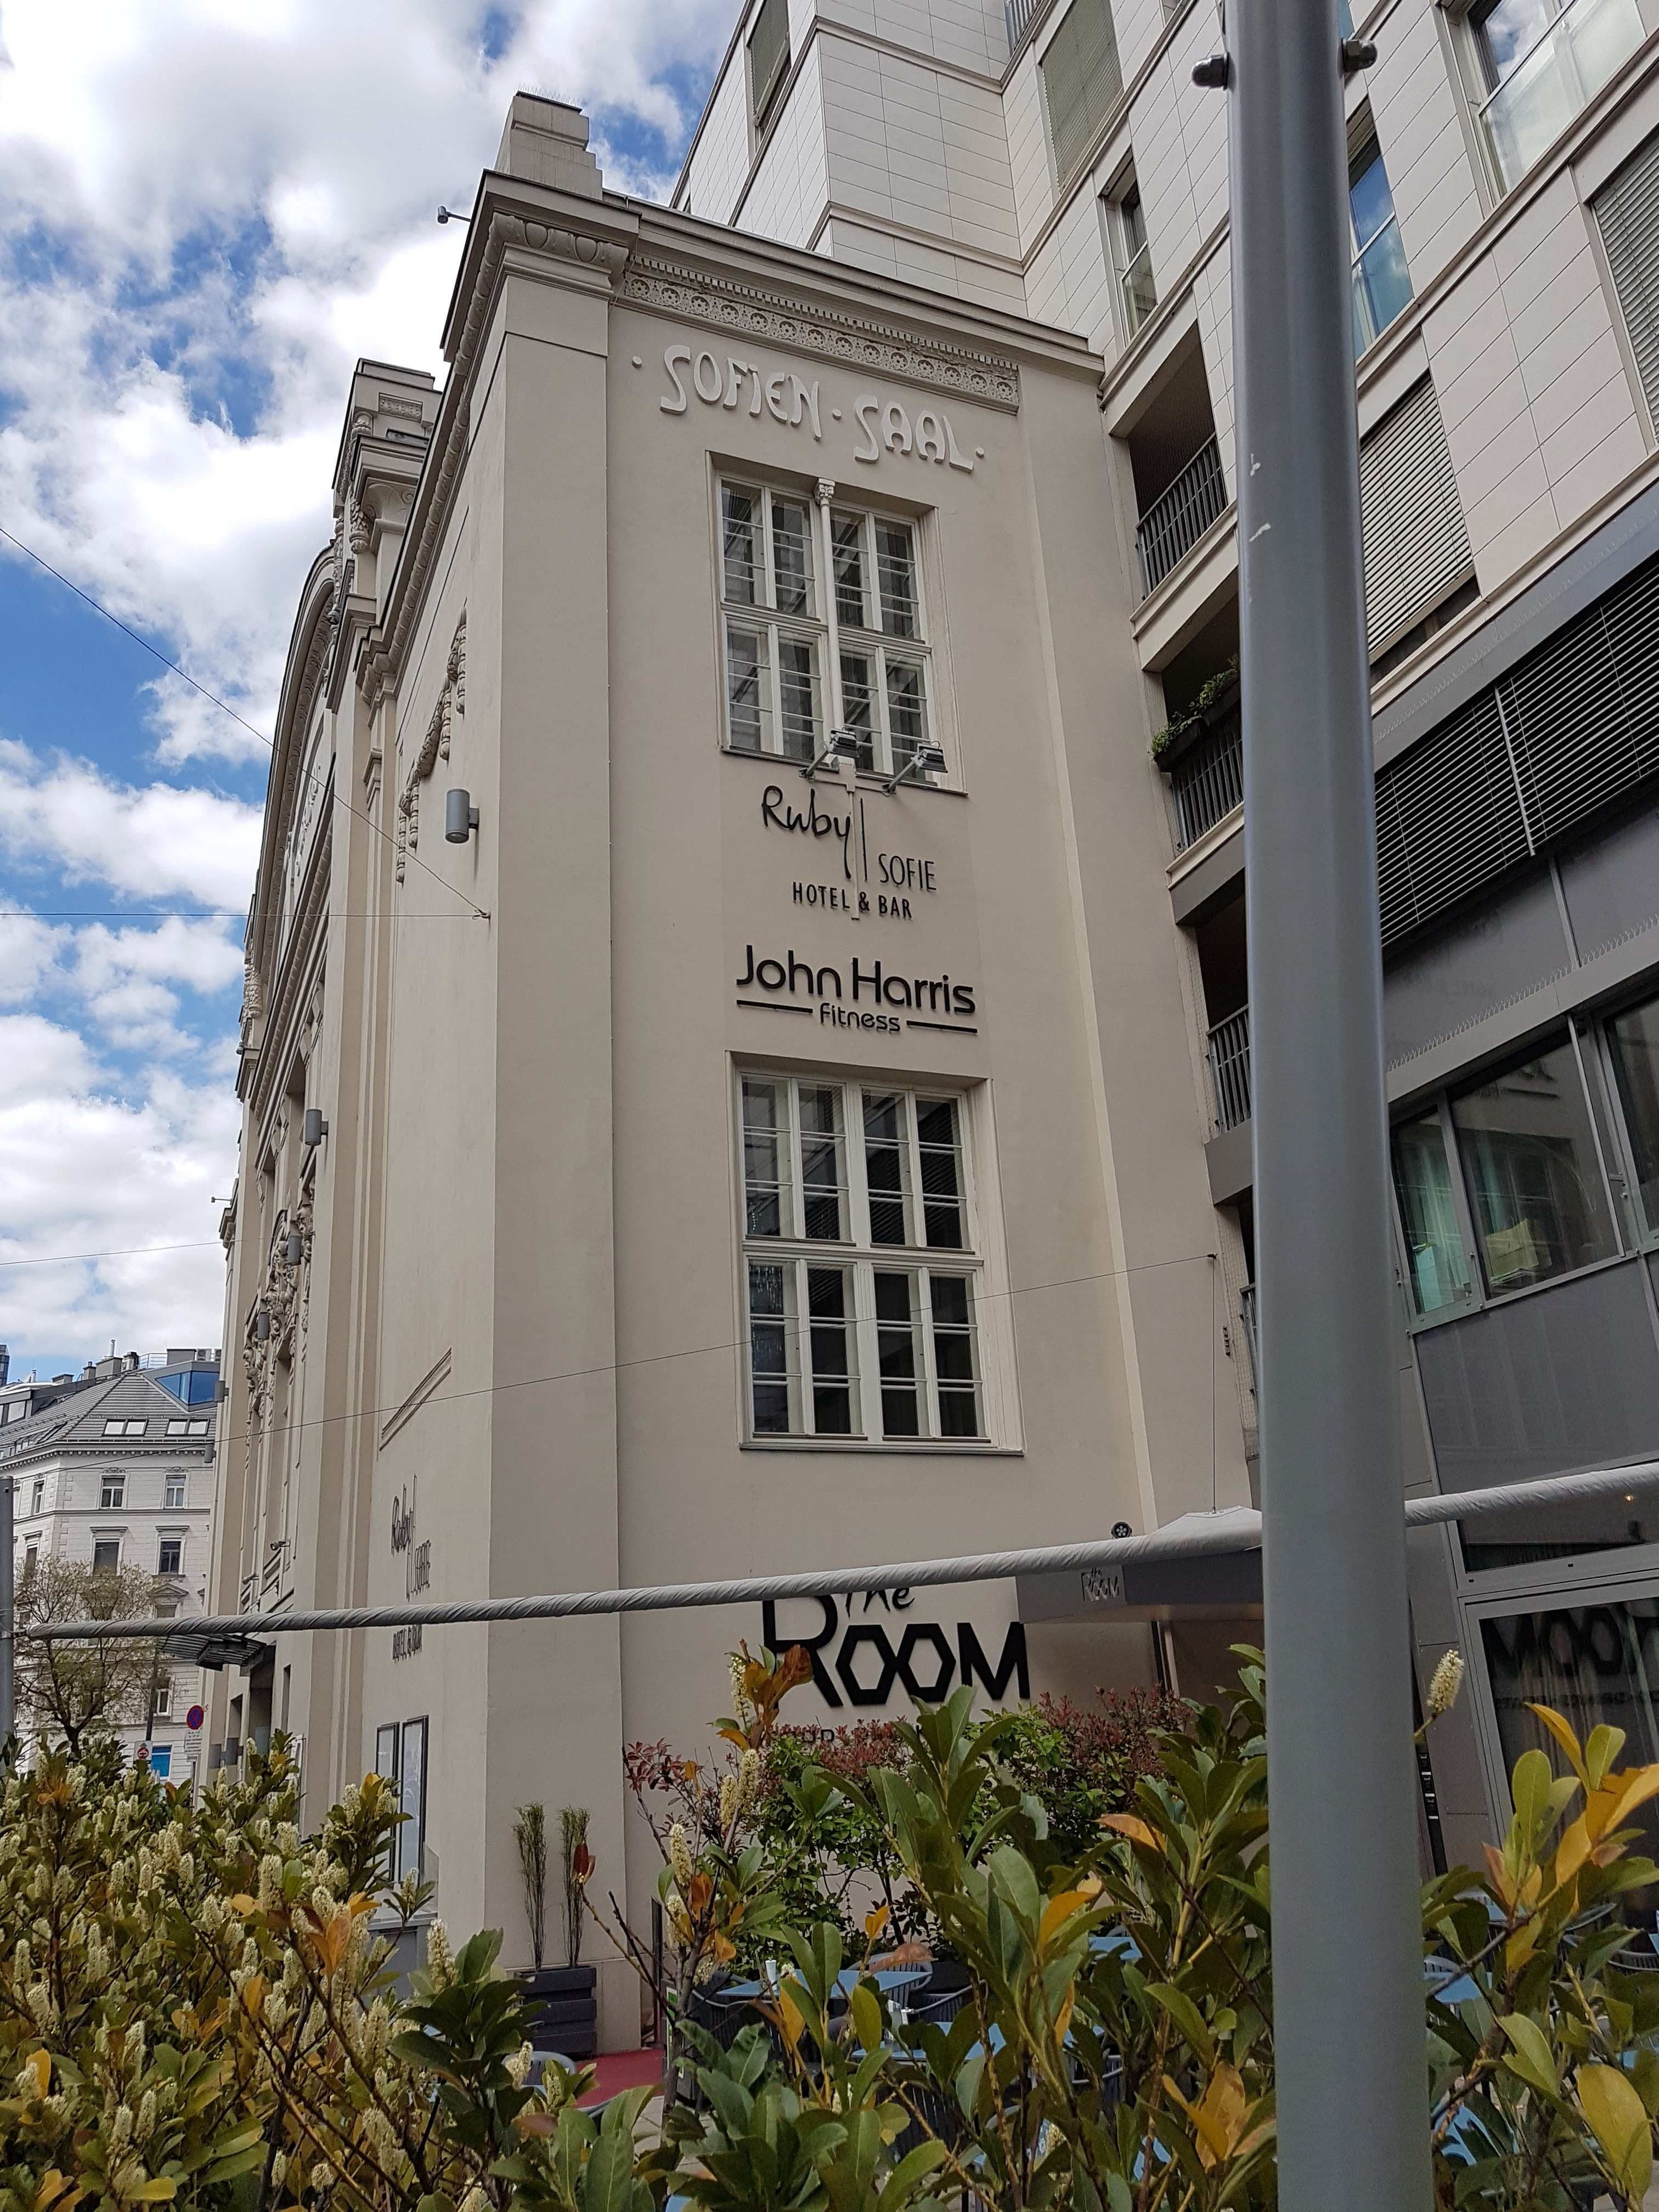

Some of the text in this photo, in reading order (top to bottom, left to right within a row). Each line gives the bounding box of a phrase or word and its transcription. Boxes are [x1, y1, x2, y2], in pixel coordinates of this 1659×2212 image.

[854, 395, 974, 473] SAAL
[762, 785, 851, 879] Ruby
[793, 882, 913, 919] HOTEL & BAR
[878, 854, 936, 891] SOFIE
[736, 945, 976, 1014] John Harris
[762, 1594, 1031, 1708] ROOM
